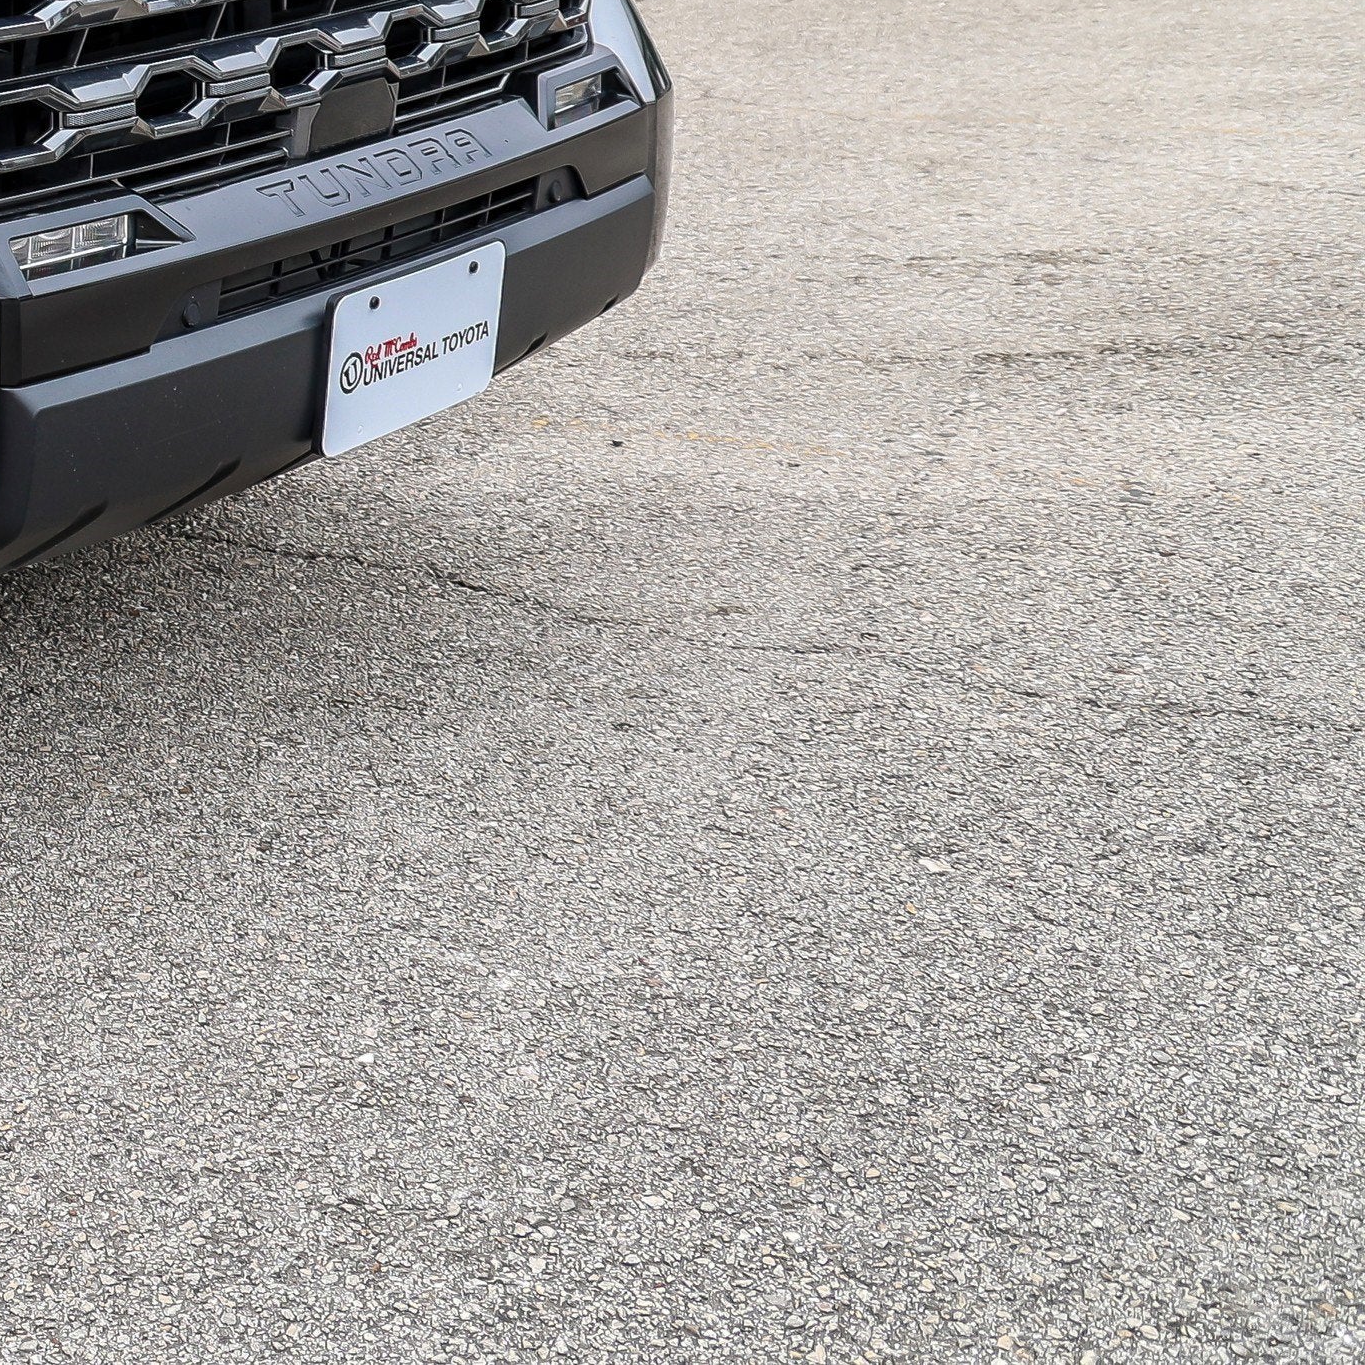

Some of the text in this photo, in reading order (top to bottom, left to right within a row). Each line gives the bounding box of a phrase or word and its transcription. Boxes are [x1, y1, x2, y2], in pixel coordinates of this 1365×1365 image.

[255, 128, 493, 218] TUNDRA
[363, 320, 489, 386] UNIVERSAL TOYOTA
[365, 343, 382, 368] Red
